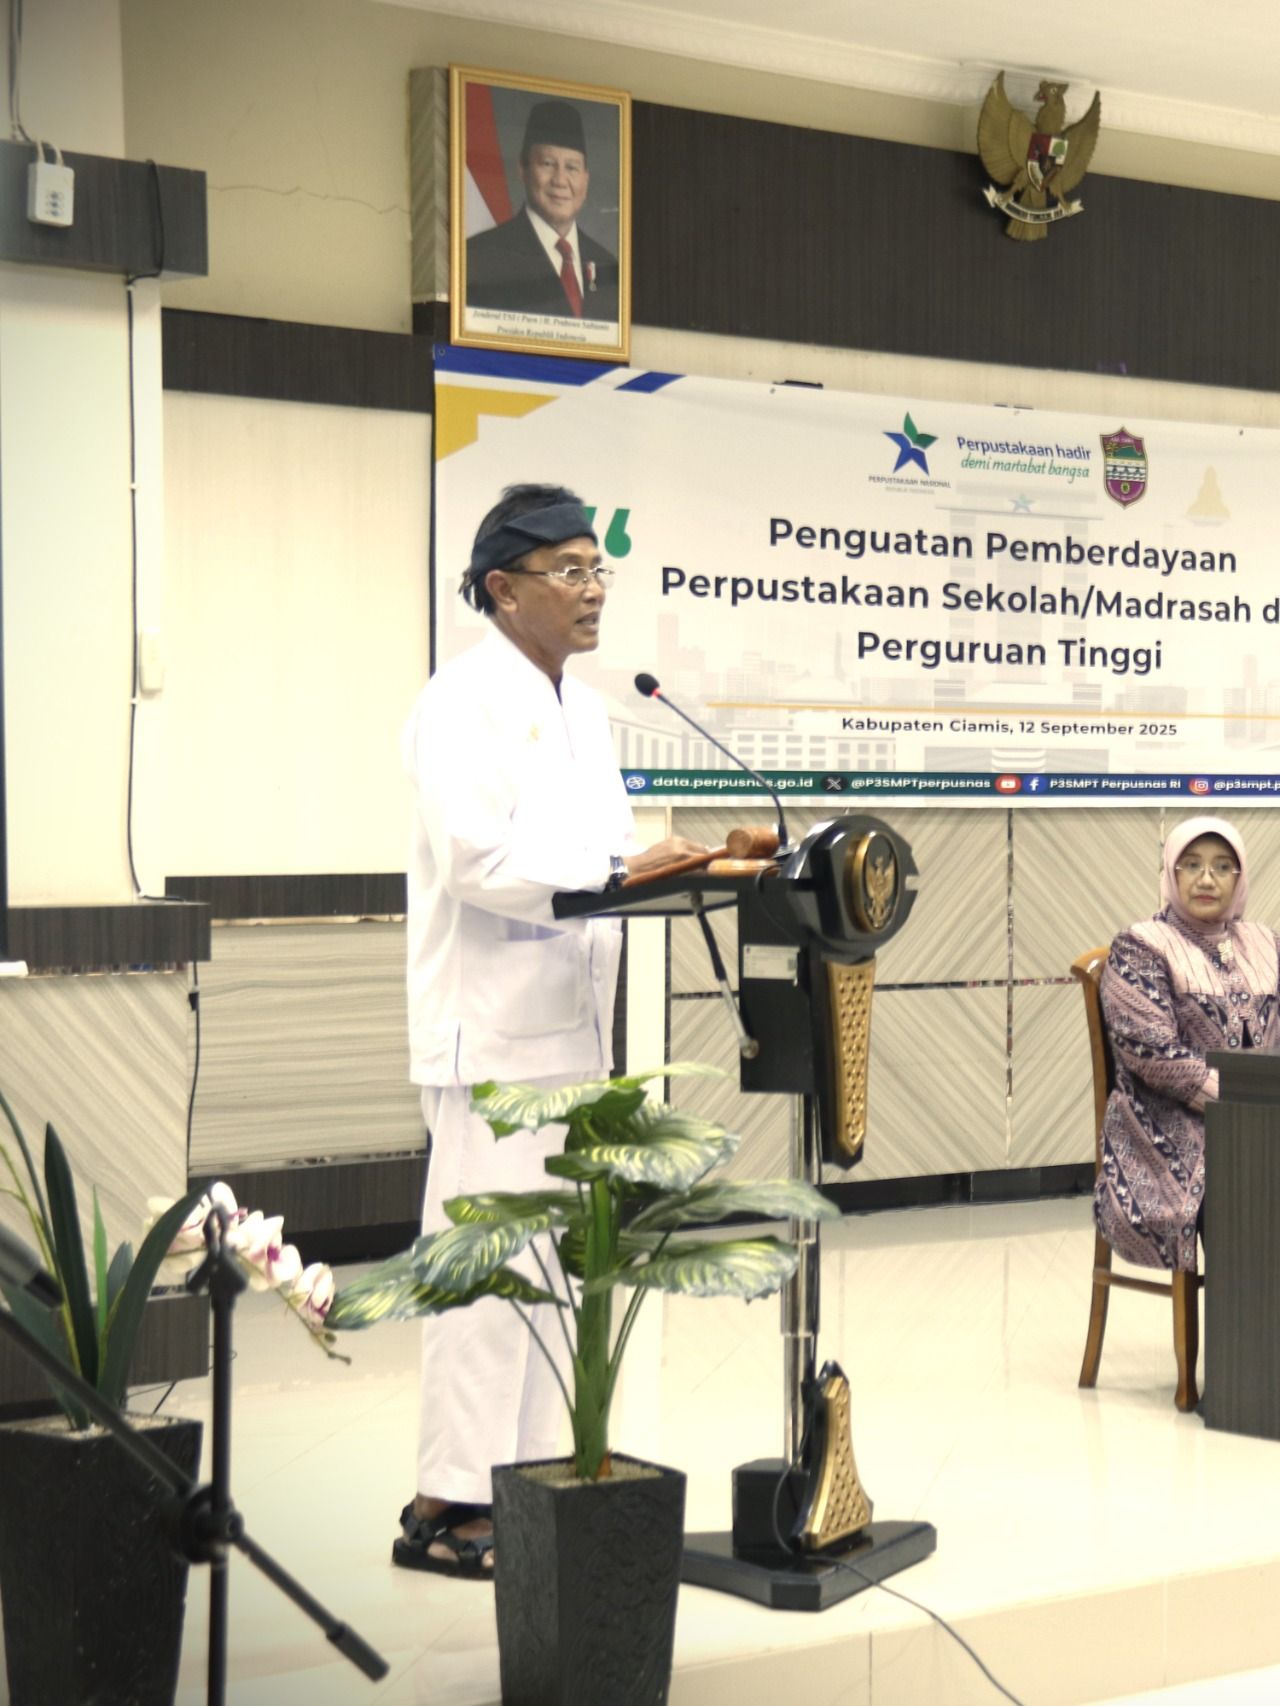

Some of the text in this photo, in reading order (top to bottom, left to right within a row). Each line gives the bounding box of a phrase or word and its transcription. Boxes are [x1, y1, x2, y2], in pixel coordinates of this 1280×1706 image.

[956, 436, 1092, 460] Perpustakaan hadir
[960, 451, 1090, 484] demi martabat bangsa
[769, 517, 1237, 577] Penguatan Pemberdayaan
[661, 566, 930, 607] Perpustakaan
[941, 581, 1252, 623] Sekolah/Madrasah
[857, 631, 1163, 677] Perguruan Tinggi
[842, 717, 1177, 736] Kabupaten Ciamis, 12 September 2025
[1101, 779, 1167, 791] Perpusnas
[1169, 779, 1181, 789] RI
